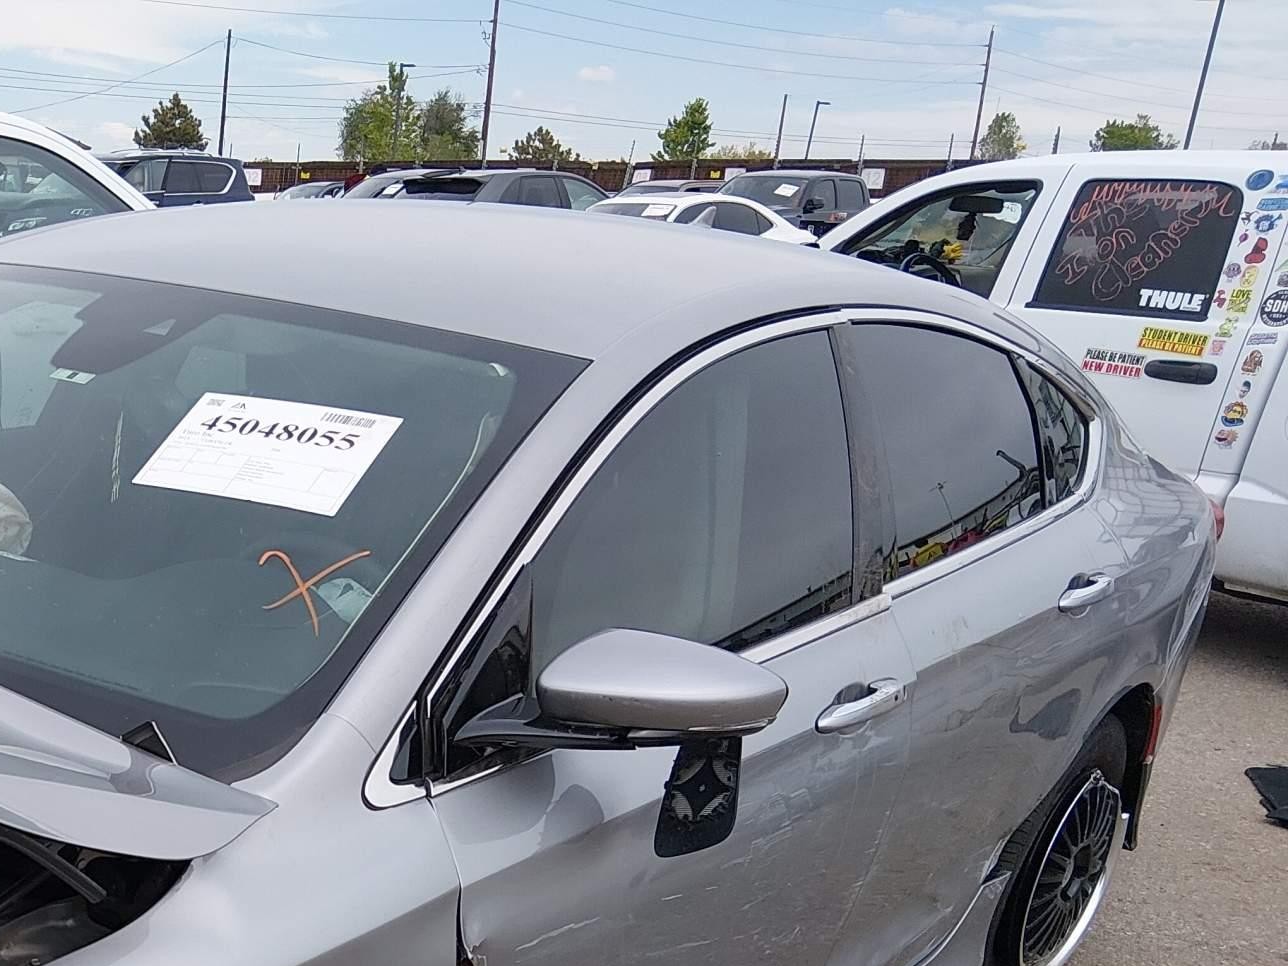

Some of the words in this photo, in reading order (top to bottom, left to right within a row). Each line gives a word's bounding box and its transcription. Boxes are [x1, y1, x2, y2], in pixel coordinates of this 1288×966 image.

[1139, 288, 1205, 312] THULE
[1231, 289, 1252, 299] LOVE
[1142, 327, 1177, 342] STUDENT
[1177, 332, 1208, 345] DRIVER
[1140, 340, 1165, 350] PLEASE
[1165, 342, 1172, 351] BE
[1172, 343, 1201, 355] PATIENT
[1085, 349, 1108, 360] PLEASE
[1108, 352, 1117, 362] BE
[1117, 353, 1144, 366] PATIENT
[1082, 360, 1104, 372] NEW
[1106, 363, 1141, 377] DRIVER
[200, 414, 361, 450] 45048055
